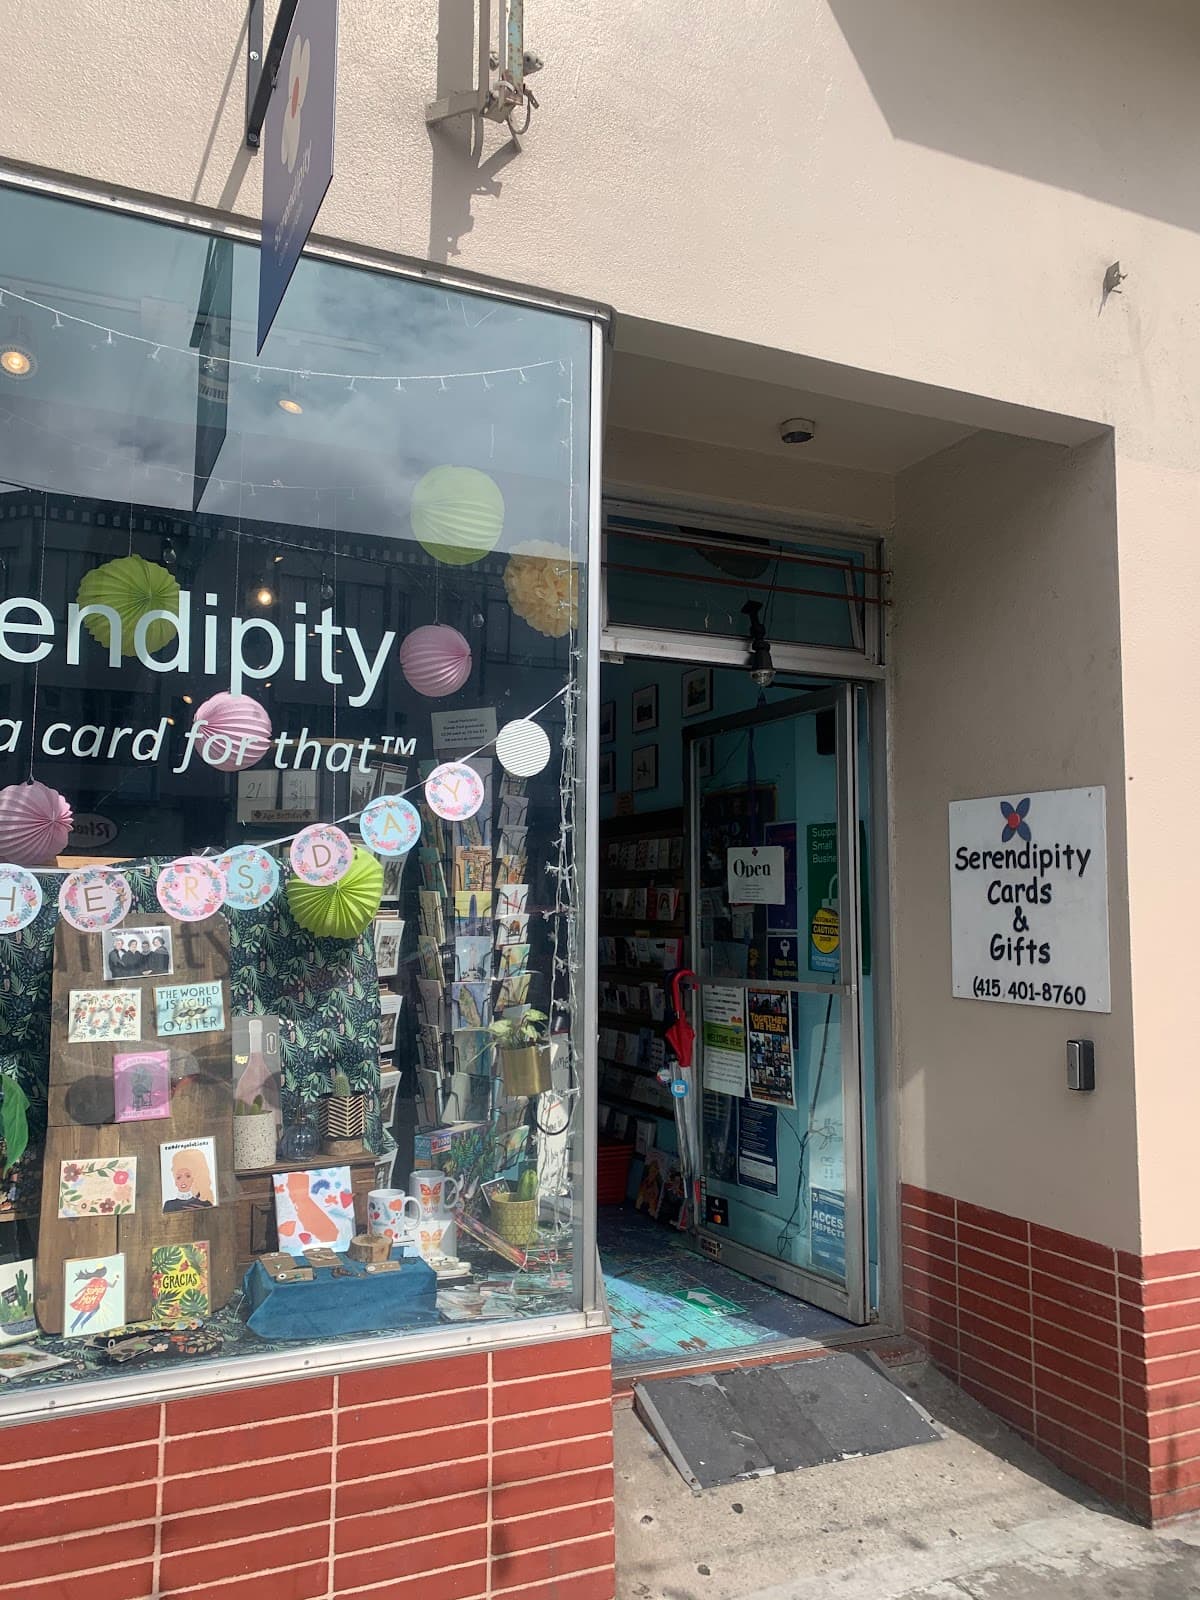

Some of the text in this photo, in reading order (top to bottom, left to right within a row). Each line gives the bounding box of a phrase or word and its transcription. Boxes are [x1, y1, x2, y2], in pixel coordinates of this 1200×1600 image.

[0, 718, 22, 753] a
[41, 716, 168, 761] card
[173, 719, 260, 774] for
[812, 839, 833, 851] Small
[954, 841, 1092, 877] Serendipity
[733, 858, 771, 879] Open
[987, 876, 1053, 905] Cards
[1012, 906, 1030, 933] &
[812, 925, 840, 936] CAUTION
[989, 933, 1052, 966] Gifts
[157, 985, 219, 1001] THE WORLD
[1007, 982, 1087, 1006] 401-8760
[165, 999, 176, 1010] IS
[163, 1017, 218, 1033] OYSTER
[750, 1012, 788, 1025] TOGETHER
[765, 1022, 786, 1033] HEAL
[162, 1273, 198, 1290] GRACIAS
